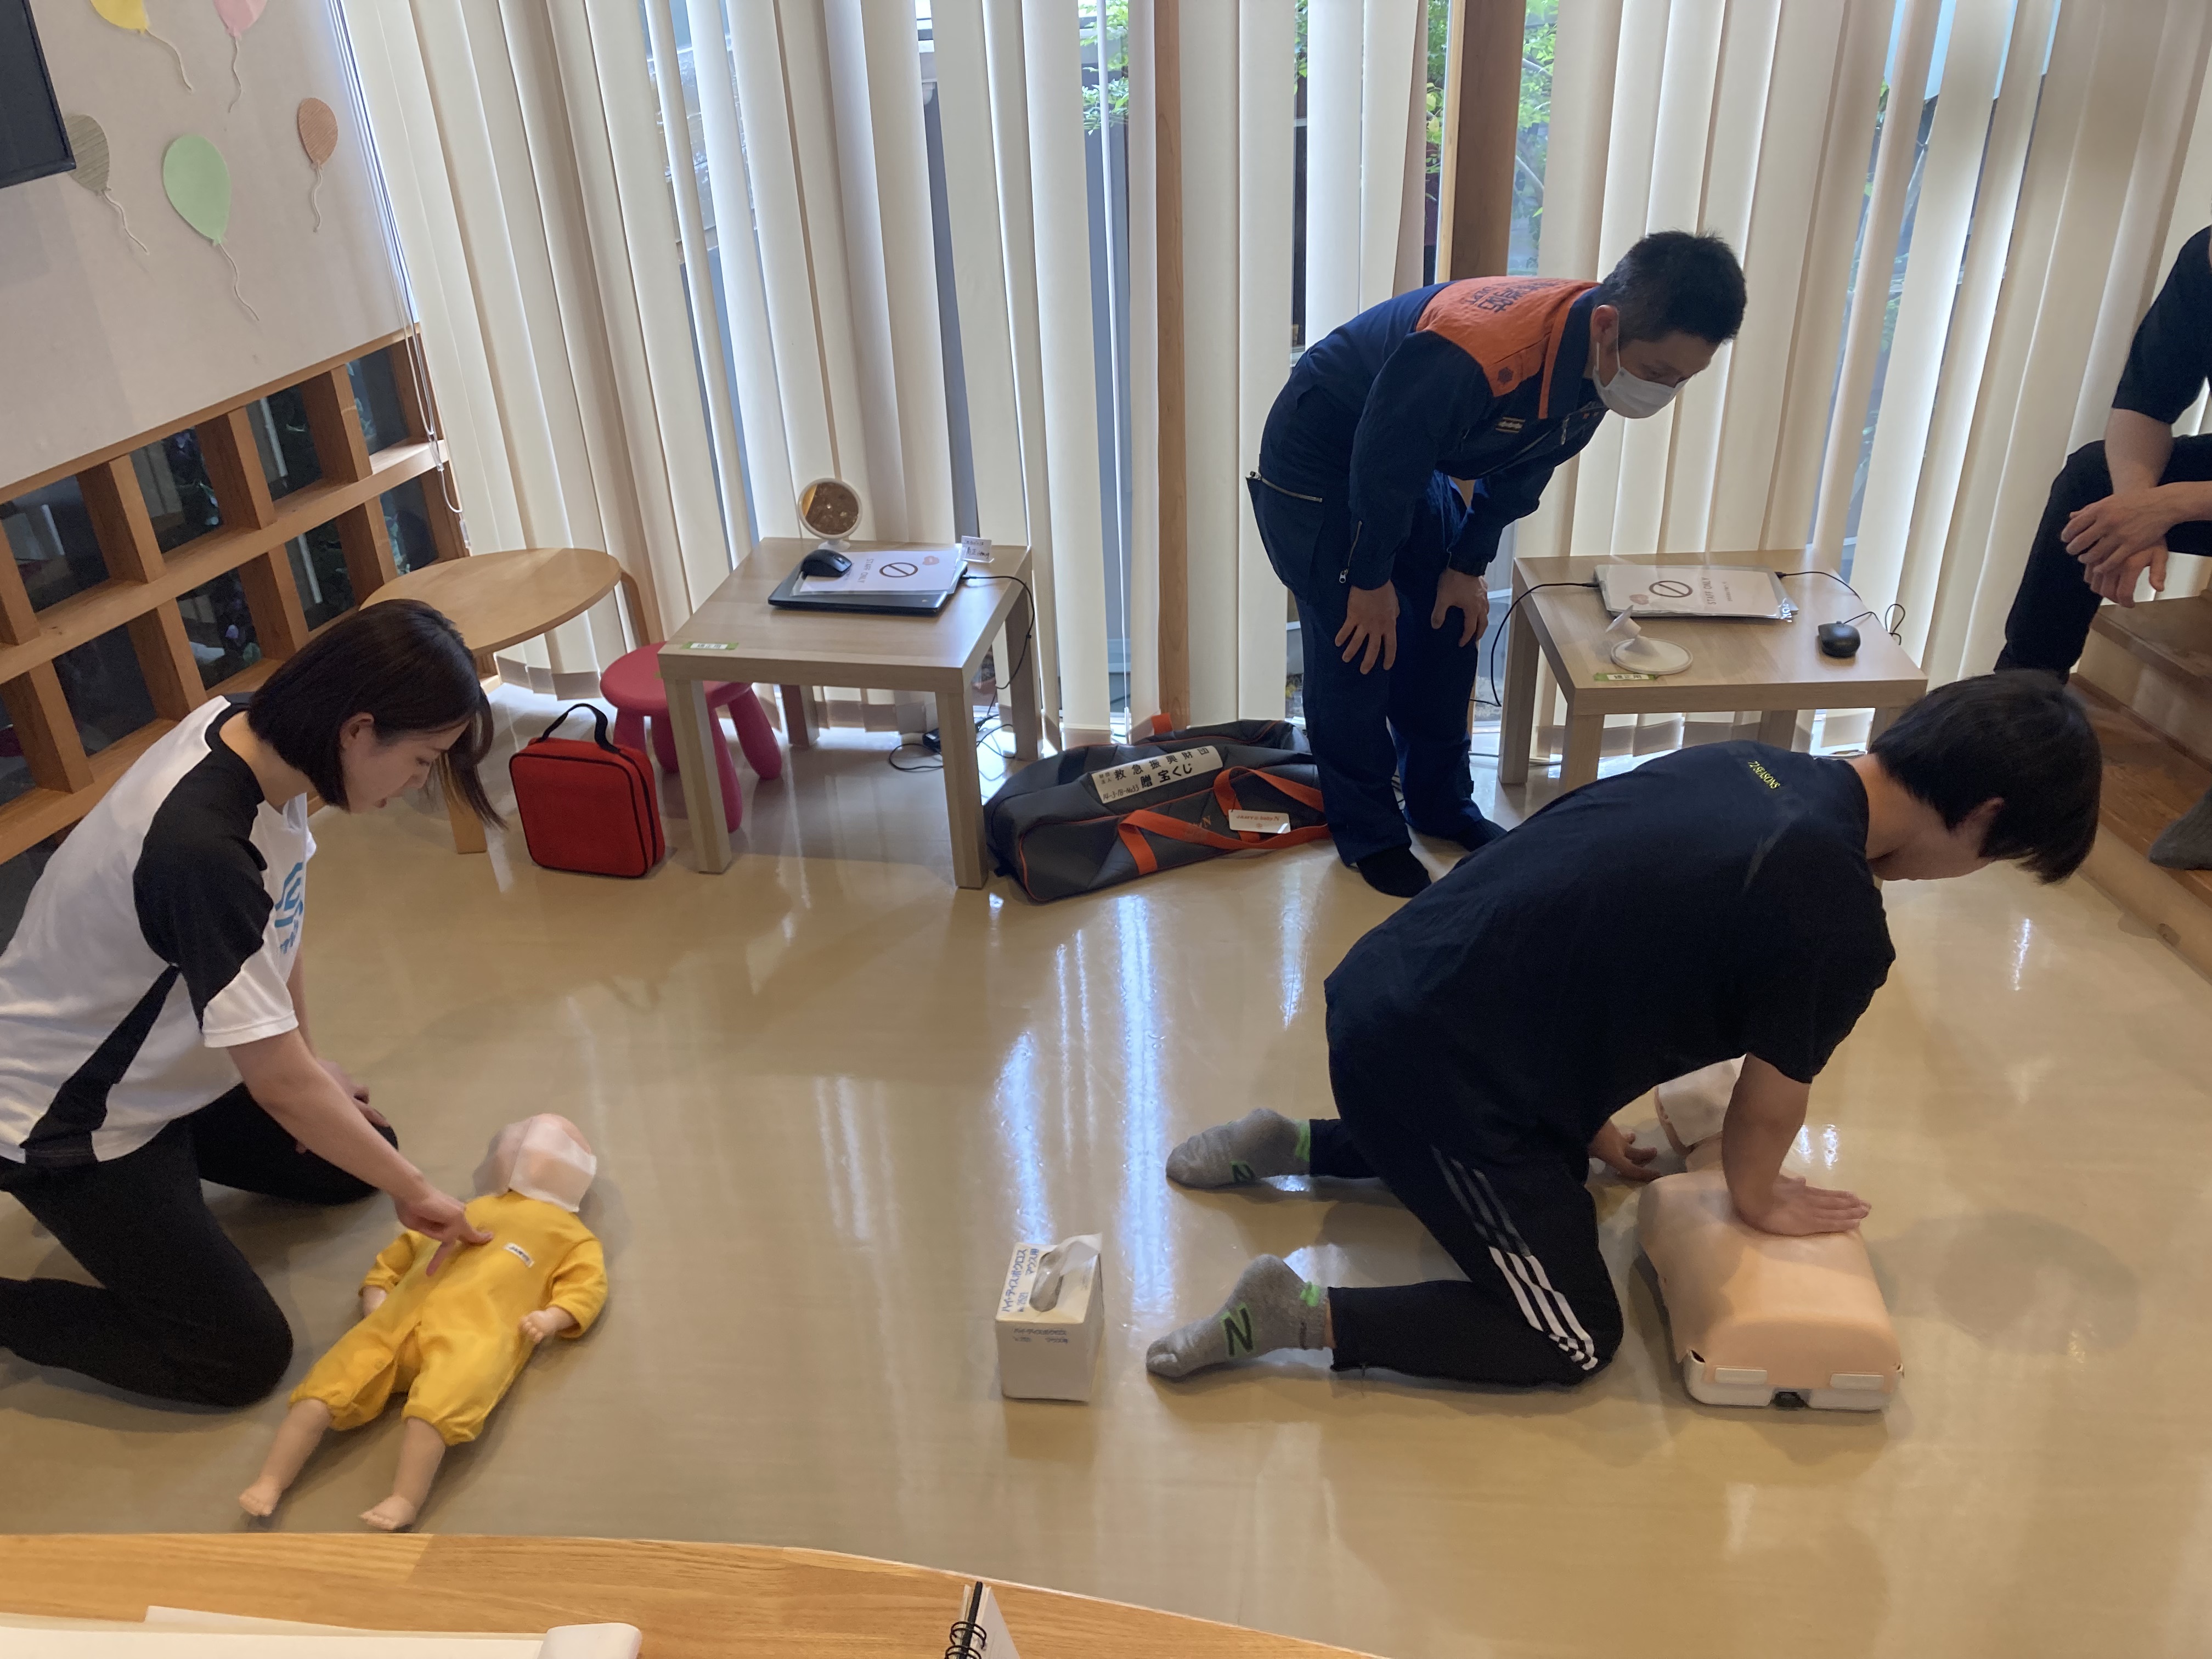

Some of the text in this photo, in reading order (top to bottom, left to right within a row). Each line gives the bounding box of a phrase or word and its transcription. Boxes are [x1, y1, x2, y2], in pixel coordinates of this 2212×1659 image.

[1701, 577, 1717, 605] STAFF ONLY
[1114, 747, 1210, 781] 救急振興財団
[1222, 1305, 1255, 1357] N
